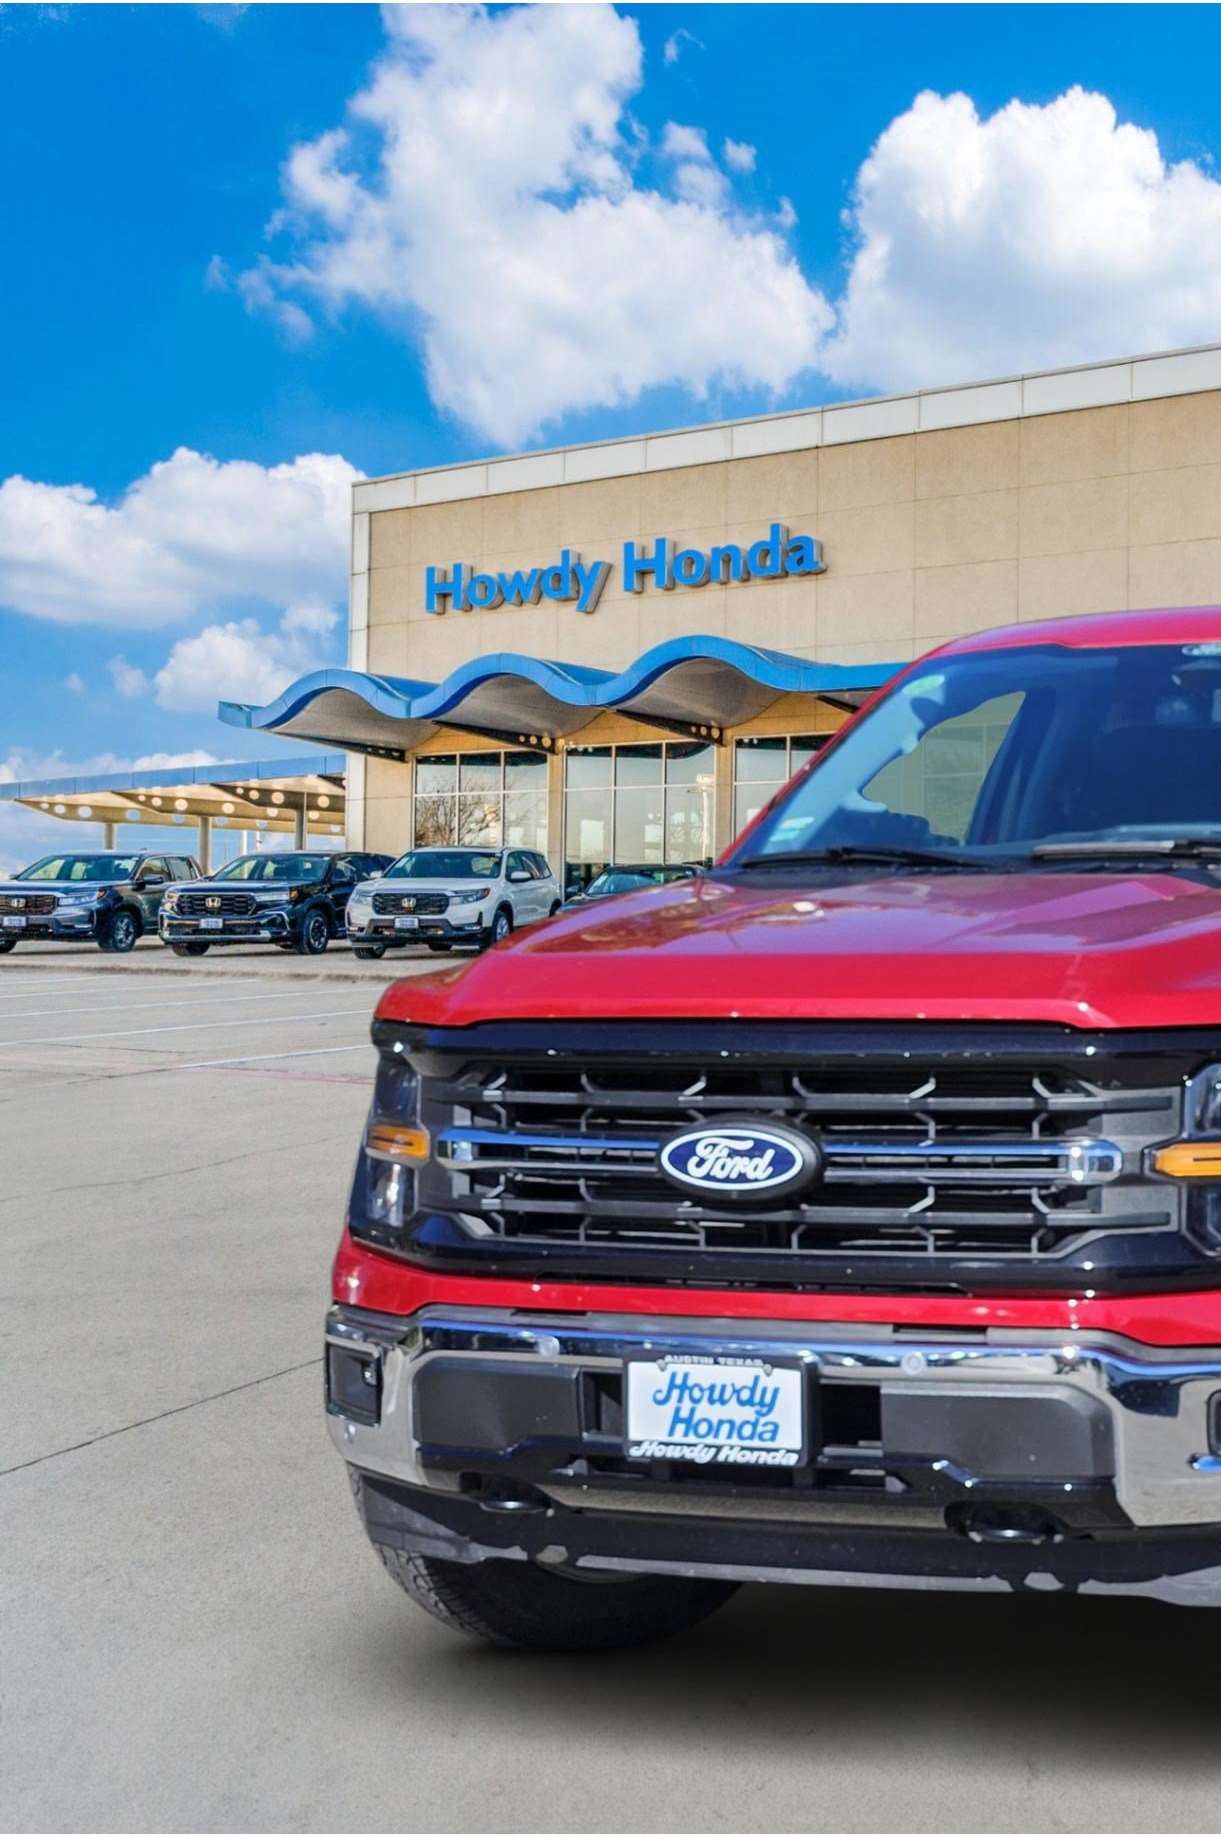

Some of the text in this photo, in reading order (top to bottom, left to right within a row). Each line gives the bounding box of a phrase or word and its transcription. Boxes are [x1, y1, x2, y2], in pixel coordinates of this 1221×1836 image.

[425, 523, 827, 615] Howdy Honda
[687, 1137, 776, 1180] Ford
[652, 1371, 780, 1417] Howdy
[667, 1406, 780, 1443] Honda
[629, 1440, 799, 1466] Howdy Honda
